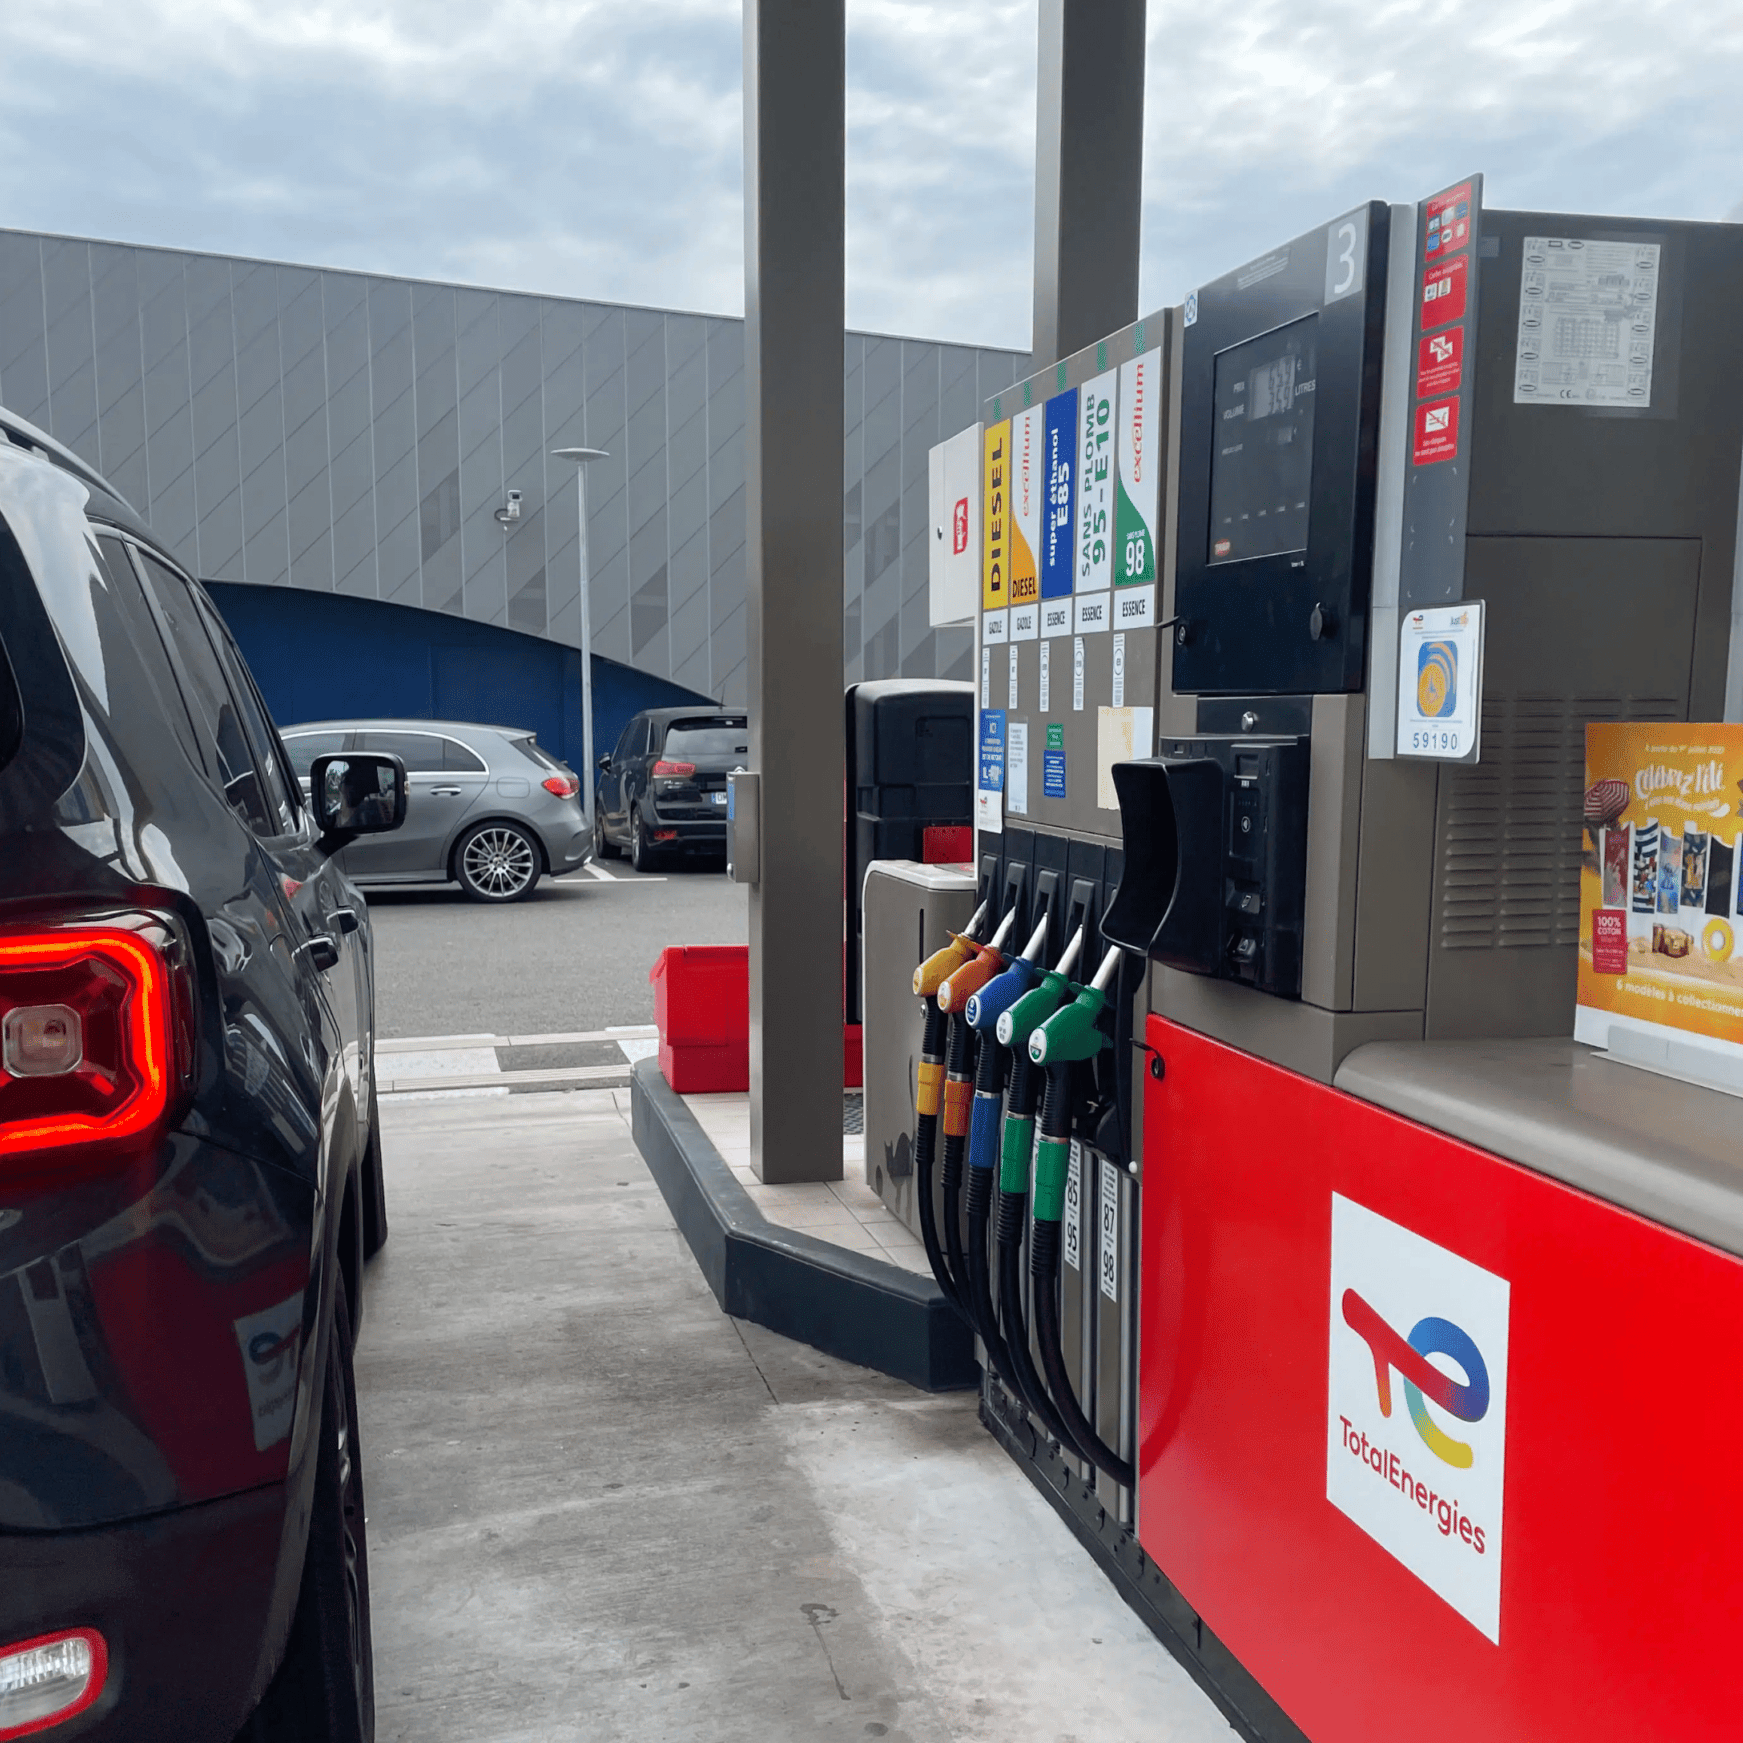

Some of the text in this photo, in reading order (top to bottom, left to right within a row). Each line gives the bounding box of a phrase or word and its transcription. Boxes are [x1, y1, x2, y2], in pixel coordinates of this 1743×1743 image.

[1334, 222, 1357, 294] 3
[1295, 379, 1316, 396] LITRES
[1133, 363, 1144, 483] excellium
[1223, 404, 1244, 419] VOLUME
[1057, 462, 1070, 527] E85
[1082, 394, 1095, 577] SANS PLOMB
[991, 437, 1003, 592] DIESEL
[1049, 511, 1058, 567] super
[1125, 539, 1145, 577] 98
[1012, 576, 1037, 598] DIESEL
[1017, 616, 1031, 630] GAZOLE
[1047, 611, 1066, 627] ESSENCE
[1082, 605, 1102, 622] ESSENCE
[1122, 599, 1146, 617] ESSENCE
[989, 620, 1002, 634] GAZOLE
[1413, 732, 1458, 750] 59190
[1597, 916, 1622, 927] 100%
[1597, 927, 1622, 935] COTON
[1067, 1176, 1078, 1207] 85
[1104, 1203, 1115, 1234] 87
[1067, 1221, 1078, 1252] 95
[1104, 1250, 1115, 1283] 98
[1339, 1414, 1486, 1555] TotalEnergies
